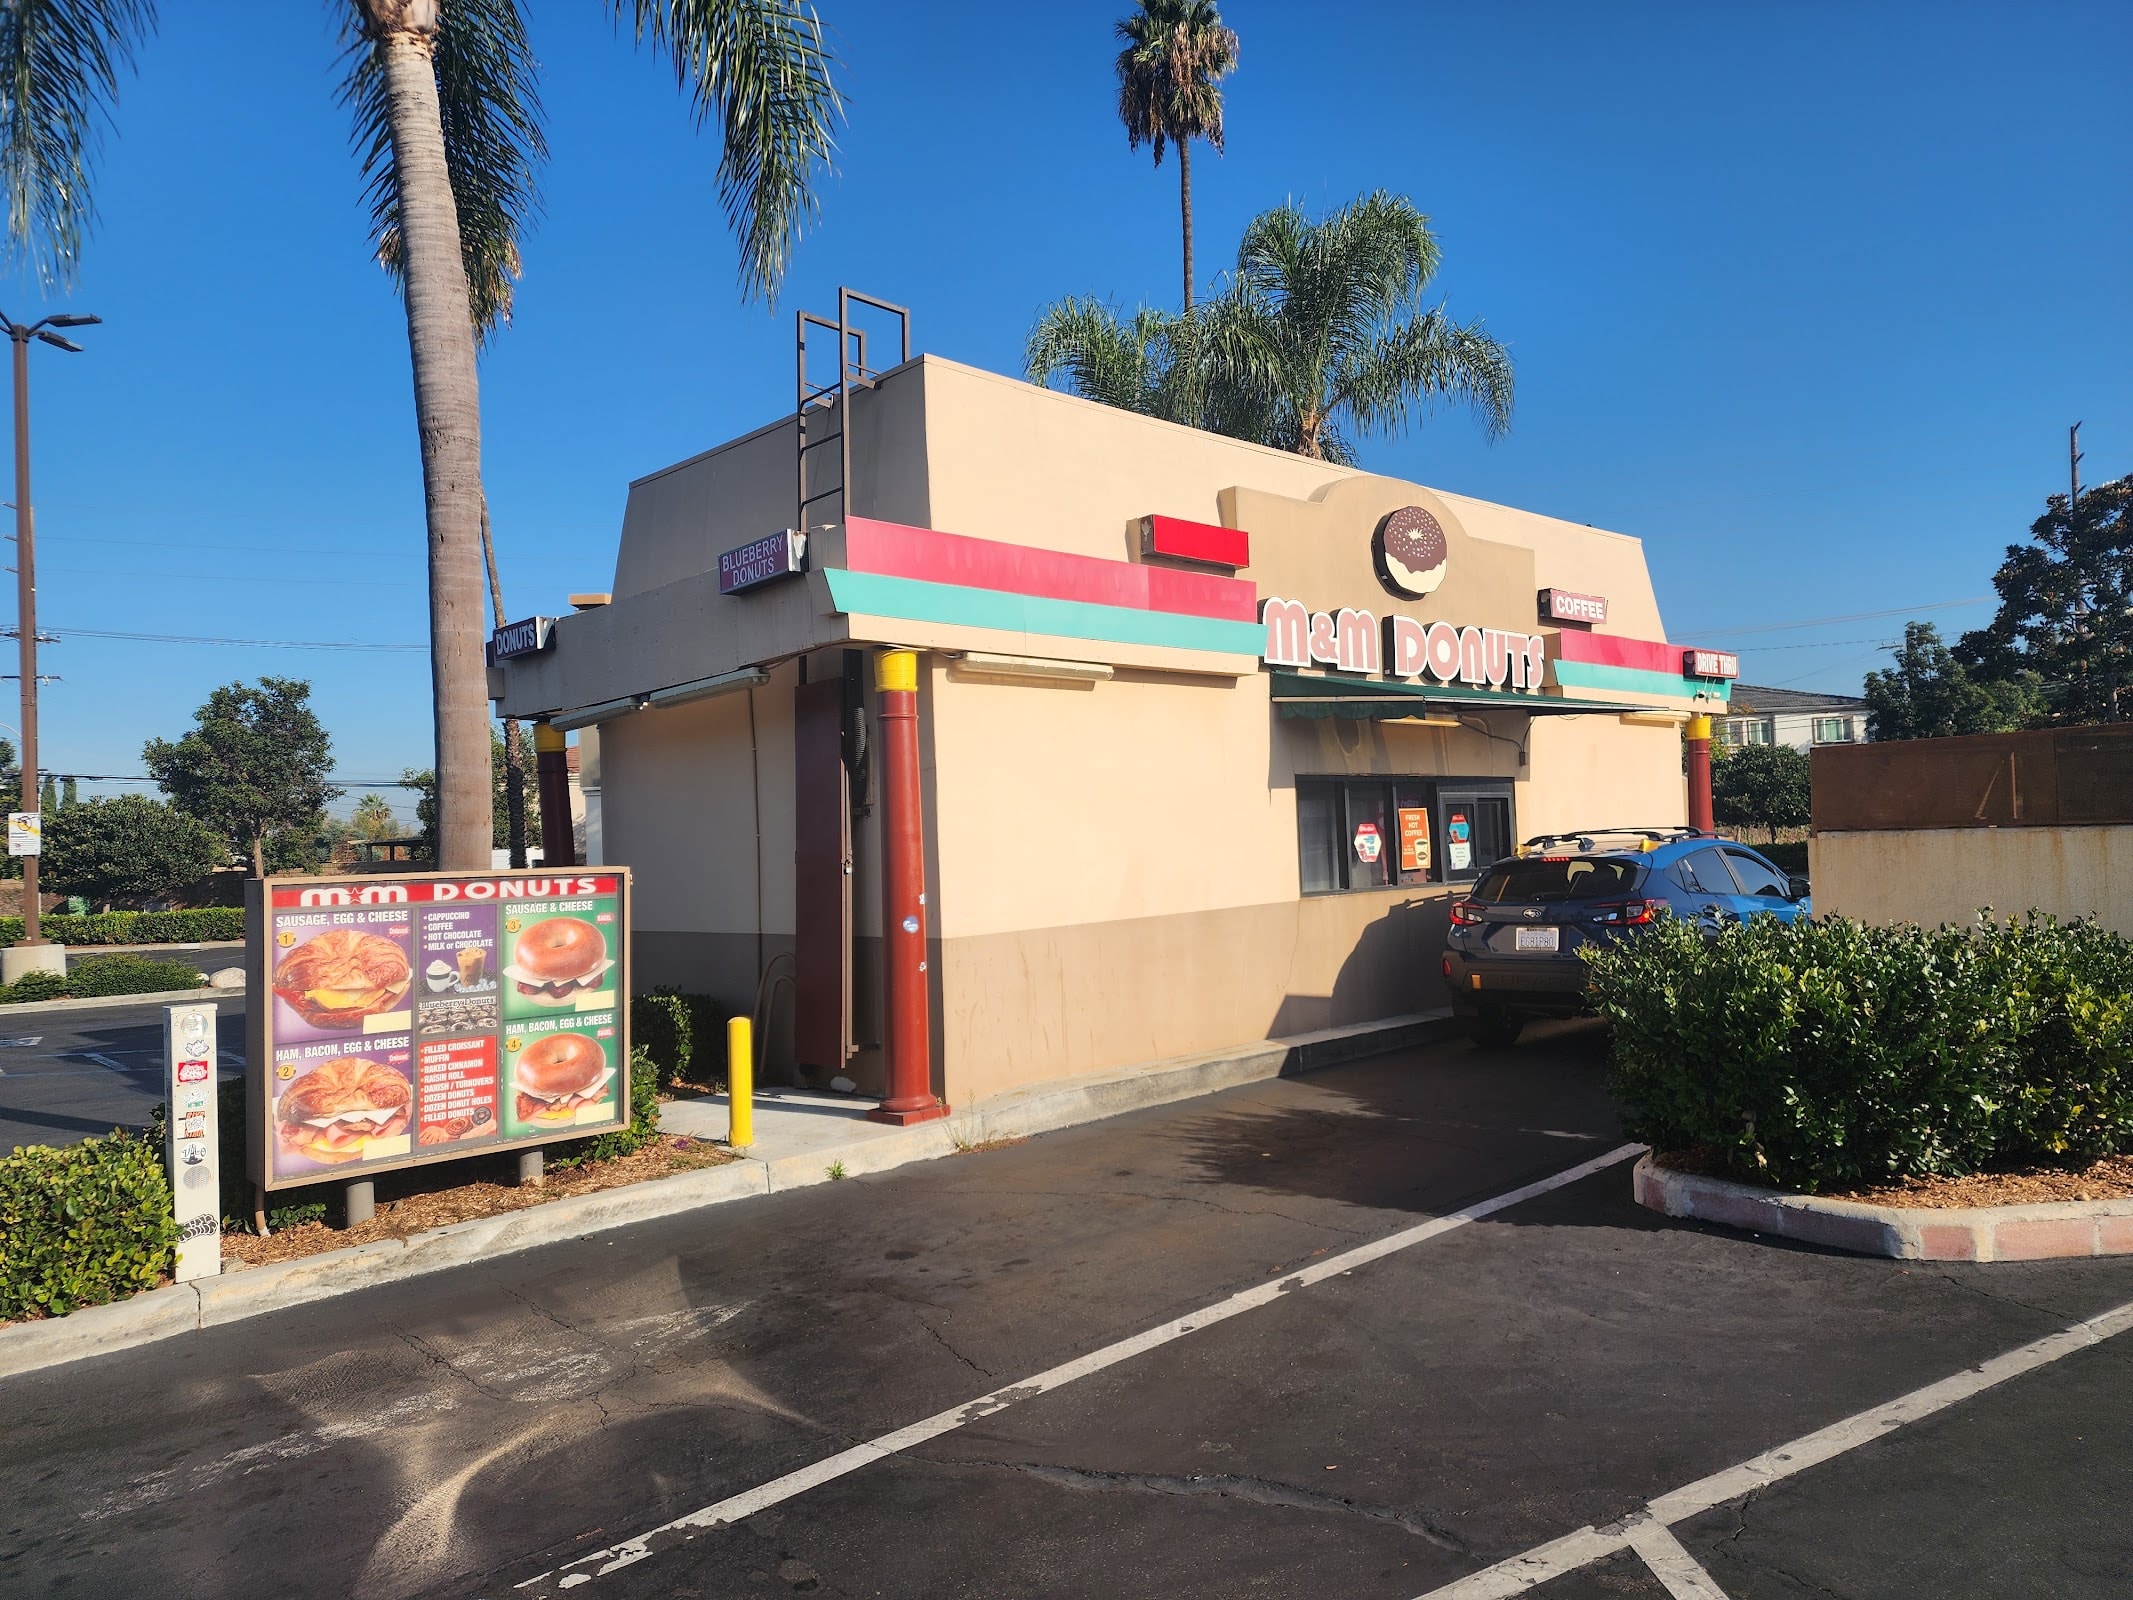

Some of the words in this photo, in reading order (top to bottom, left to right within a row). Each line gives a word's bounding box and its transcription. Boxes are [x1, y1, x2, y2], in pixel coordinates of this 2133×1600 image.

[722, 534, 784, 573] BLUEBERRY
[732, 556, 775, 587] DONUTS
[1556, 595, 1604, 620] COFFEE
[496, 623, 535, 656] DONUTS
[1262, 595, 1379, 673] M&M
[1392, 614, 1544, 689] DONUTS
[1697, 651, 1719, 674] DRIVE
[1719, 654, 1737, 676] THRU
[1405, 829, 1422, 837] COFFEE
[433, 878, 597, 901] DONUTS
[505, 902, 547, 914] SAUSAGE
[549, 902, 557, 912] &
[559, 900, 593, 911] CHEESE
[276, 914, 329, 928] SAUSAGE,
[333, 912, 354, 924] EGG
[357, 911, 365, 923] &
[368, 910, 408, 922] CHEESE
[428, 911, 470, 921] CAPPUCCINO
[428, 922, 453, 931] COFFEE
[428, 932, 442, 941] HOT
[443, 930, 482, 940] CHOCOLATE
[428, 942, 445, 951] MILK
[455, 939, 493, 949] CHOCOLATE
[464, 996, 494, 1006] Donuts
[505, 1023, 526, 1035] HAM,
[528, 1020, 557, 1032] BACON,
[559, 1018, 574, 1029] EGG
[576, 1017, 582, 1027] &
[584, 1013, 612, 1026] CHEESE
[275, 1047, 301, 1061] HAM,
[304, 1044, 341, 1058] BACON,
[343, 1041, 362, 1053] EGG
[364, 1040, 372, 1052] &
[374, 1036, 410, 1050] CHEESE
[424, 1044, 446, 1054] FILLED
[448, 1039, 485, 1052] CROISSANT
[424, 1053, 450, 1064] MUFFIN
[424, 1063, 447, 1074] BAKED
[448, 1058, 483, 1071] CINNAMON
[424, 1073, 447, 1084] RAISIN
[448, 1070, 465, 1080] ROLL
[424, 1082, 450, 1093] DANISH
[455, 1076, 494, 1089] TURNOVERS
[424, 1092, 447, 1103] DOZEN
[448, 1088, 474, 1100] DONUTS
[424, 1102, 447, 1113] DOZEN
[448, 1098, 470, 1109] DONUT
[472, 1095, 493, 1106] HOLES
[424, 1112, 447, 1123] FILLED
[448, 1107, 475, 1119] DONUTS
